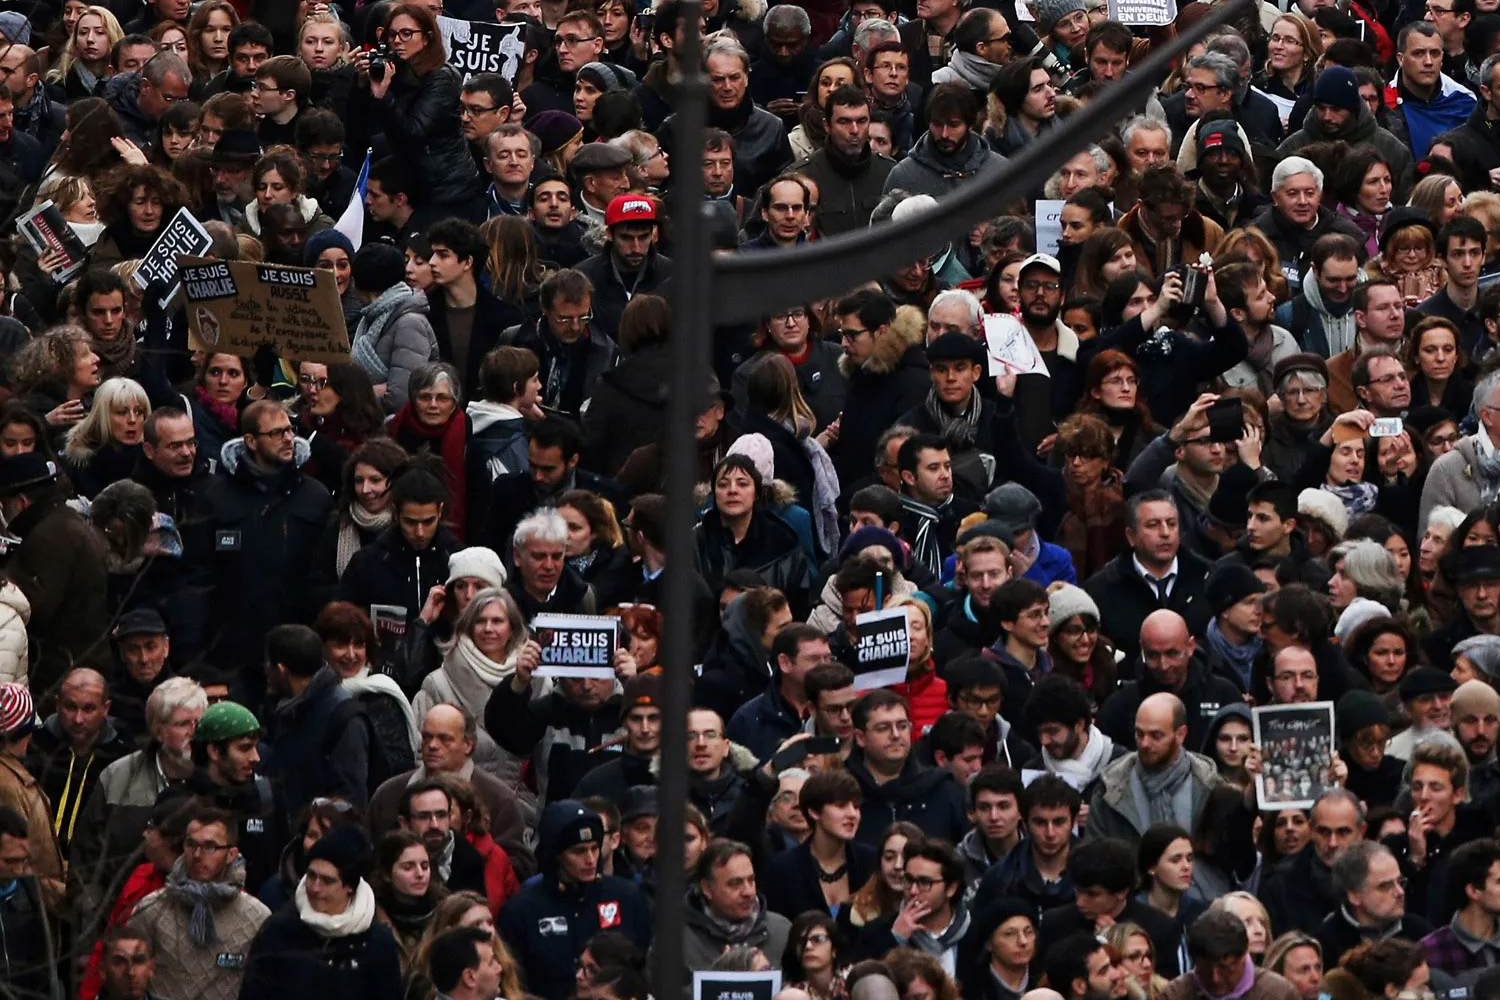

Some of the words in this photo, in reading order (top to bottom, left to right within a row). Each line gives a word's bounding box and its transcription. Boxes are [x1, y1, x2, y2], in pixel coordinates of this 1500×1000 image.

[1117, 13, 1135, 22] EN
[1137, 13, 1172, 23] DEUIL
[466, 33, 491, 52] JE
[454, 50, 500, 73] SUIS
[141, 257, 161, 275] JE
[158, 221, 188, 259] SUIS
[184, 266, 199, 281] JE
[199, 264, 230, 280] SUIS
[261, 268, 279, 283] JE
[280, 270, 314, 285] SUIS
[186, 277, 237, 299] CHARLIE
[551, 631, 569, 648] JE
[571, 632, 608, 648] SUIS
[857, 634, 875, 649] JE
[876, 629, 906, 646] SUIS
[541, 646, 608, 664] CHARLIE
[858, 641, 907, 663] CHARLIE
[717, 992, 730, 1000] JE
[731, 991, 755, 1000] SUIS
